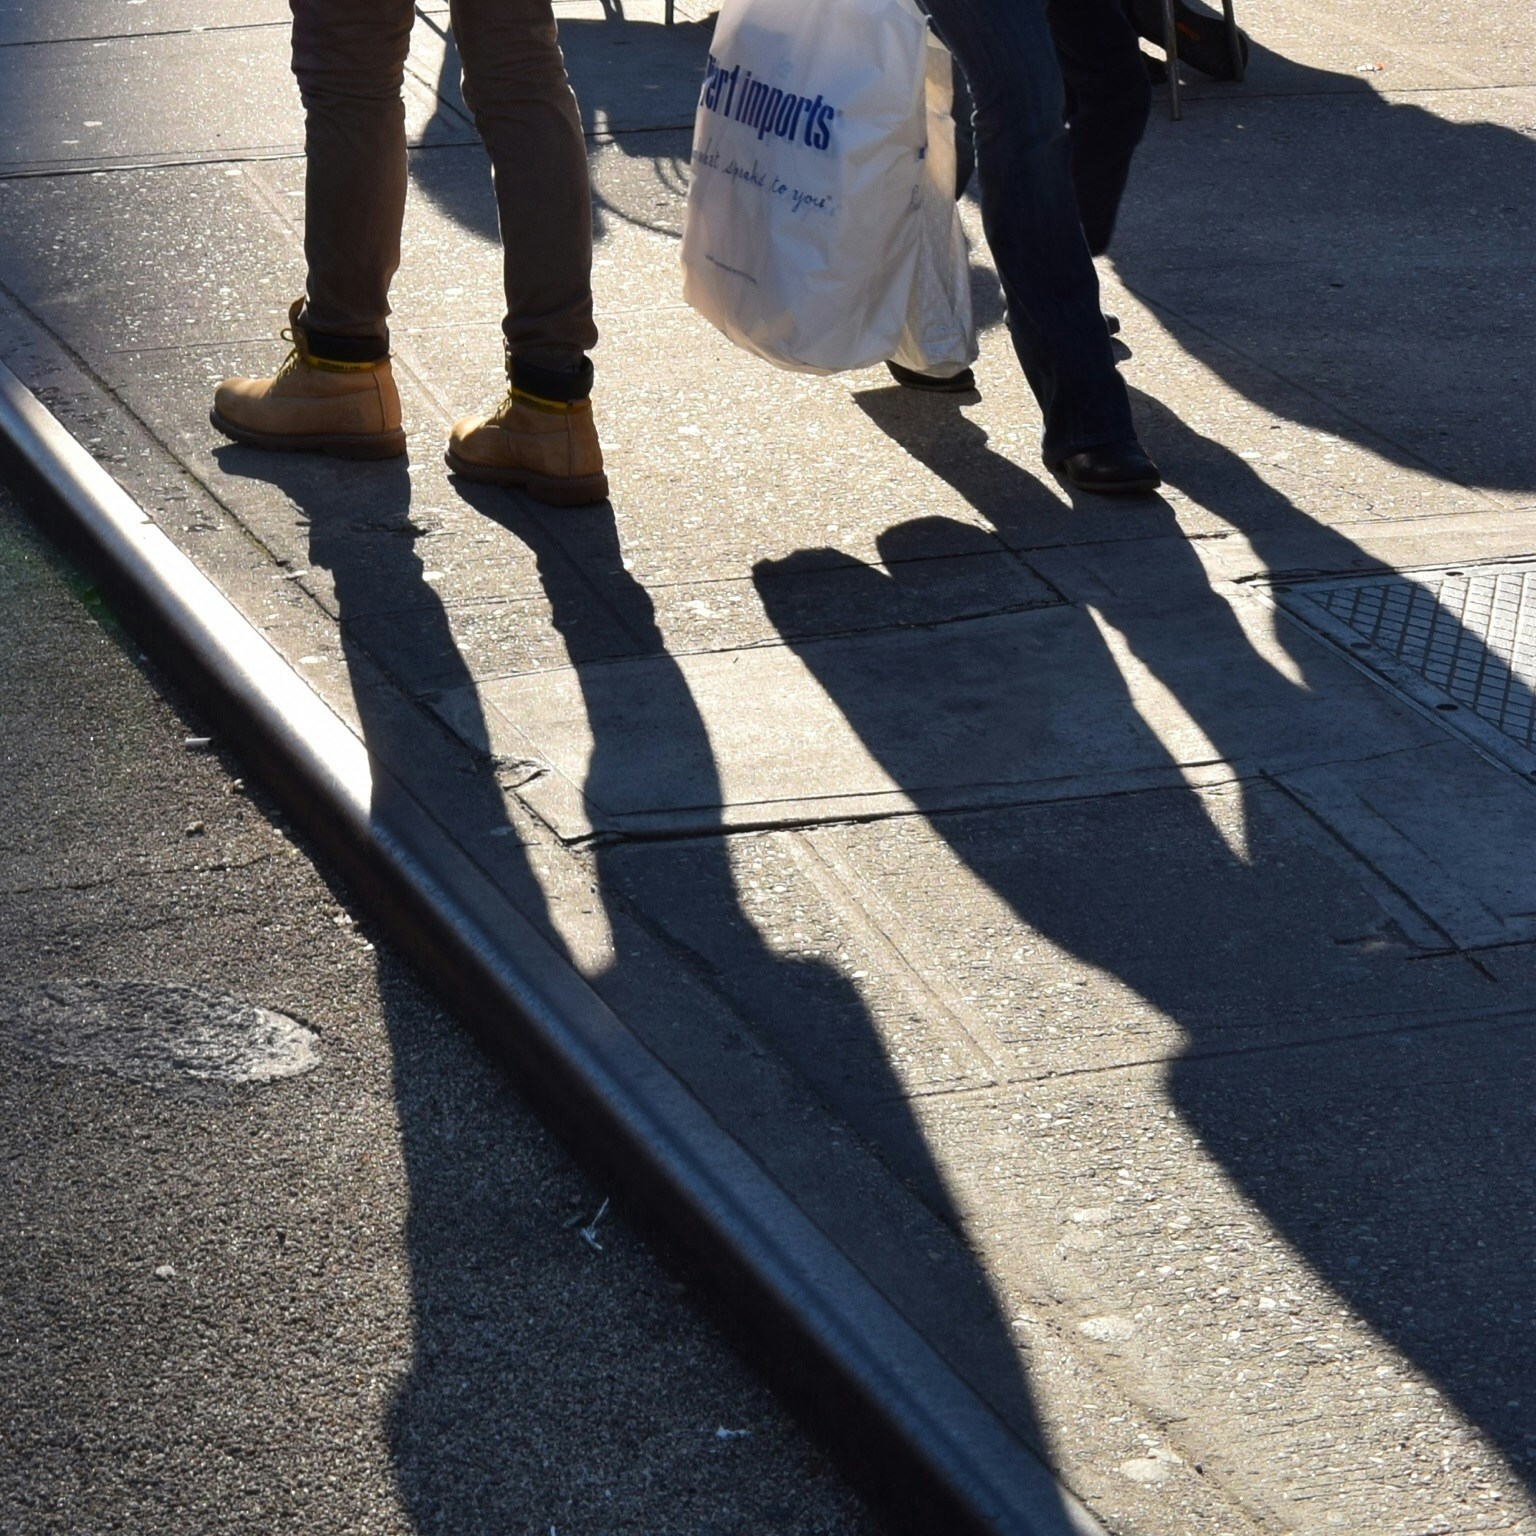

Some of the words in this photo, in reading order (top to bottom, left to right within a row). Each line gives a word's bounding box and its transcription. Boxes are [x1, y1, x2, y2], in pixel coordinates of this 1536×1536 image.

[735, 70, 835, 150] imports
[771, 174, 787, 194] to
[791, 189, 826, 213] you
